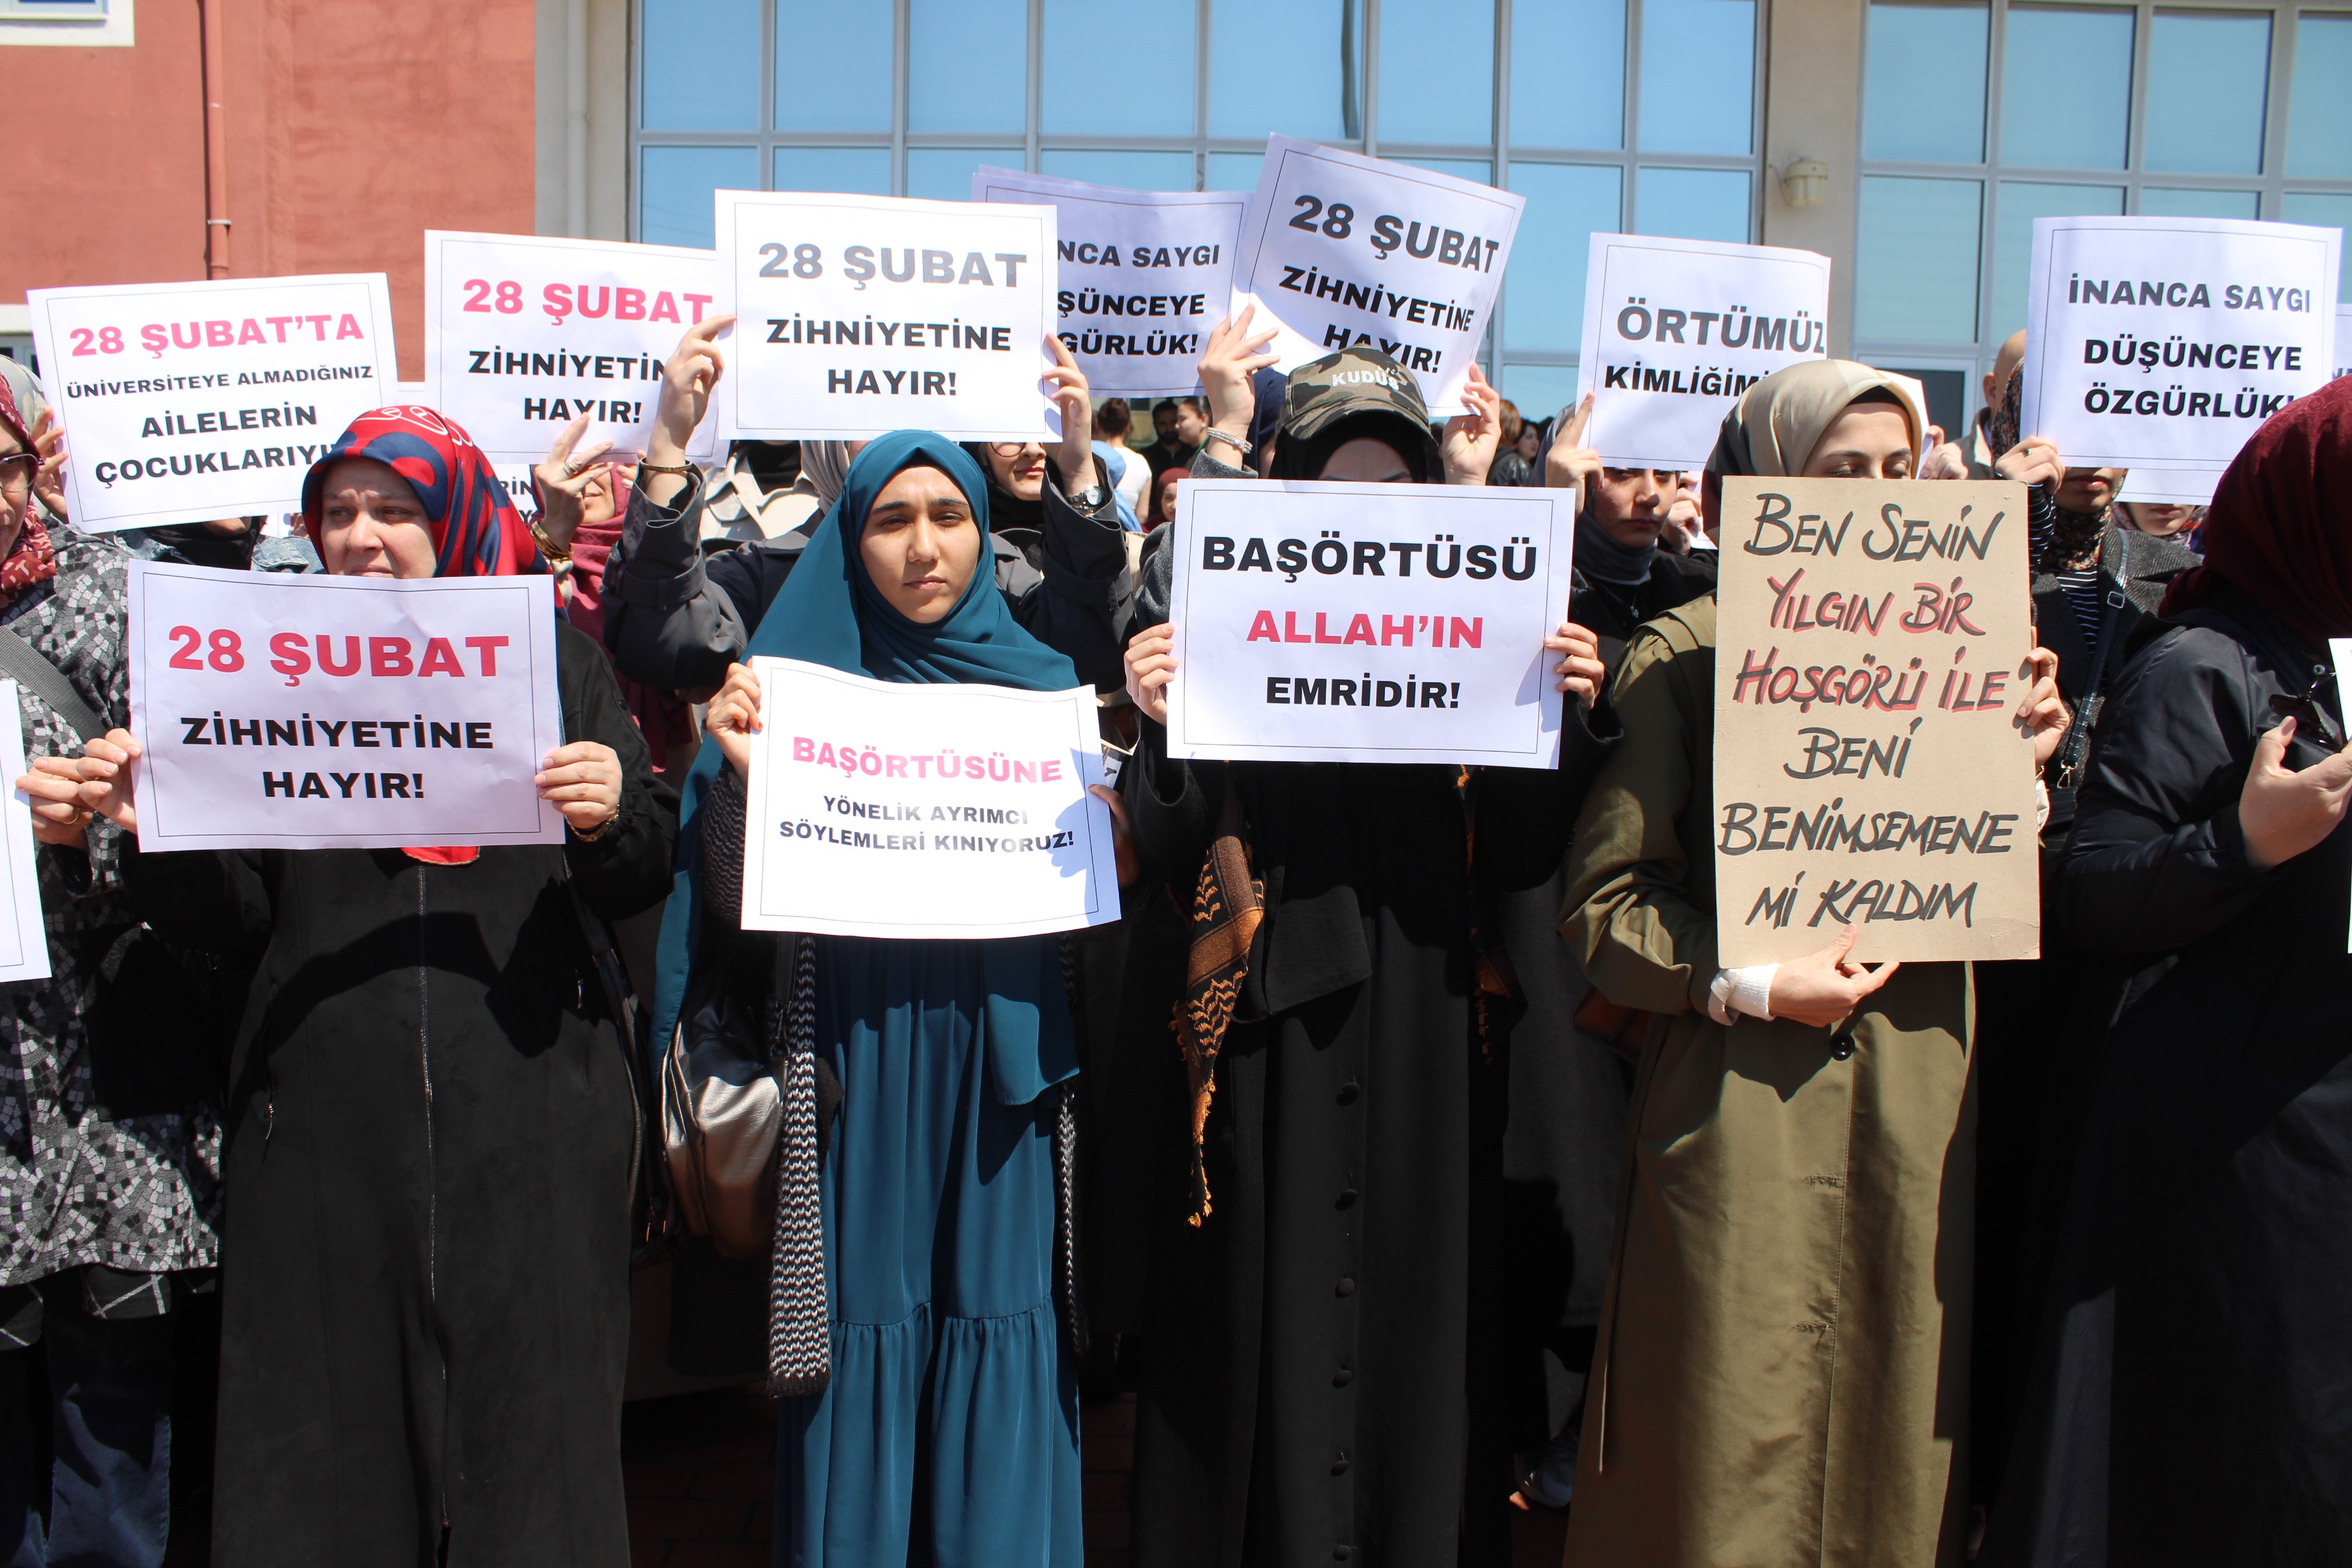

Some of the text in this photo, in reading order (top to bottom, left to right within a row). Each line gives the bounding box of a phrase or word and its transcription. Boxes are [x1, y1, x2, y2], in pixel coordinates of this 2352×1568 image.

[1057, 240, 1220, 267] NCA SAYGI
[1289, 195, 1500, 274] 28 ŞUBAT
[759, 243, 1027, 290] 28 ŞUBAT
[462, 279, 713, 326] 28 ŞUBAT
[1057, 288, 1206, 318] ŞÜNCEYE
[1279, 265, 1475, 332] ZİHNİYETİNE
[2068, 273, 2310, 313] İNANCA SAYGI
[69, 326, 125, 357] 28
[766, 312, 1011, 351] ZİHNİYETİNE
[1057, 328, 1198, 356] GÜRLÜK!
[1617, 297, 1825, 354] ÖRTÜMÜZ
[468, 345, 664, 381] ZİHNİYETİN
[2083, 334, 2302, 373] DÜŞÜNCEYE
[67, 364, 373, 399] ÜNİVERSİTEYE ALMADIĞINIZ
[828, 370, 956, 396] HAYIR!
[141, 401, 318, 438] AİLELERİN
[524, 397, 642, 424] HAYIR!
[1203, 531, 1536, 583] BAŞÖRTÜSÜ
[1899, 576, 1986, 636] BİR
[168, 626, 509, 687] 28 ŞUBAT
[1266, 672, 1460, 708] EMRİDİR!
[1938, 645, 2010, 712] İLE
[181, 711, 494, 749] ZİHNİYETİNE
[1783, 717, 1923, 779] BENİ
[793, 736, 1062, 783] BAŞÖRTÜSÜNE
[262, 772, 424, 799] HAYIR!
[824, 795, 1028, 825] YÖNELİK AYRIMCI
[1717, 797, 2018, 856] BENİMSEMENE
[779, 819, 1074, 854] SÖYLEMLERİ KINIYORUZ!
[1745, 870, 1978, 929] Mİ KALDIM
